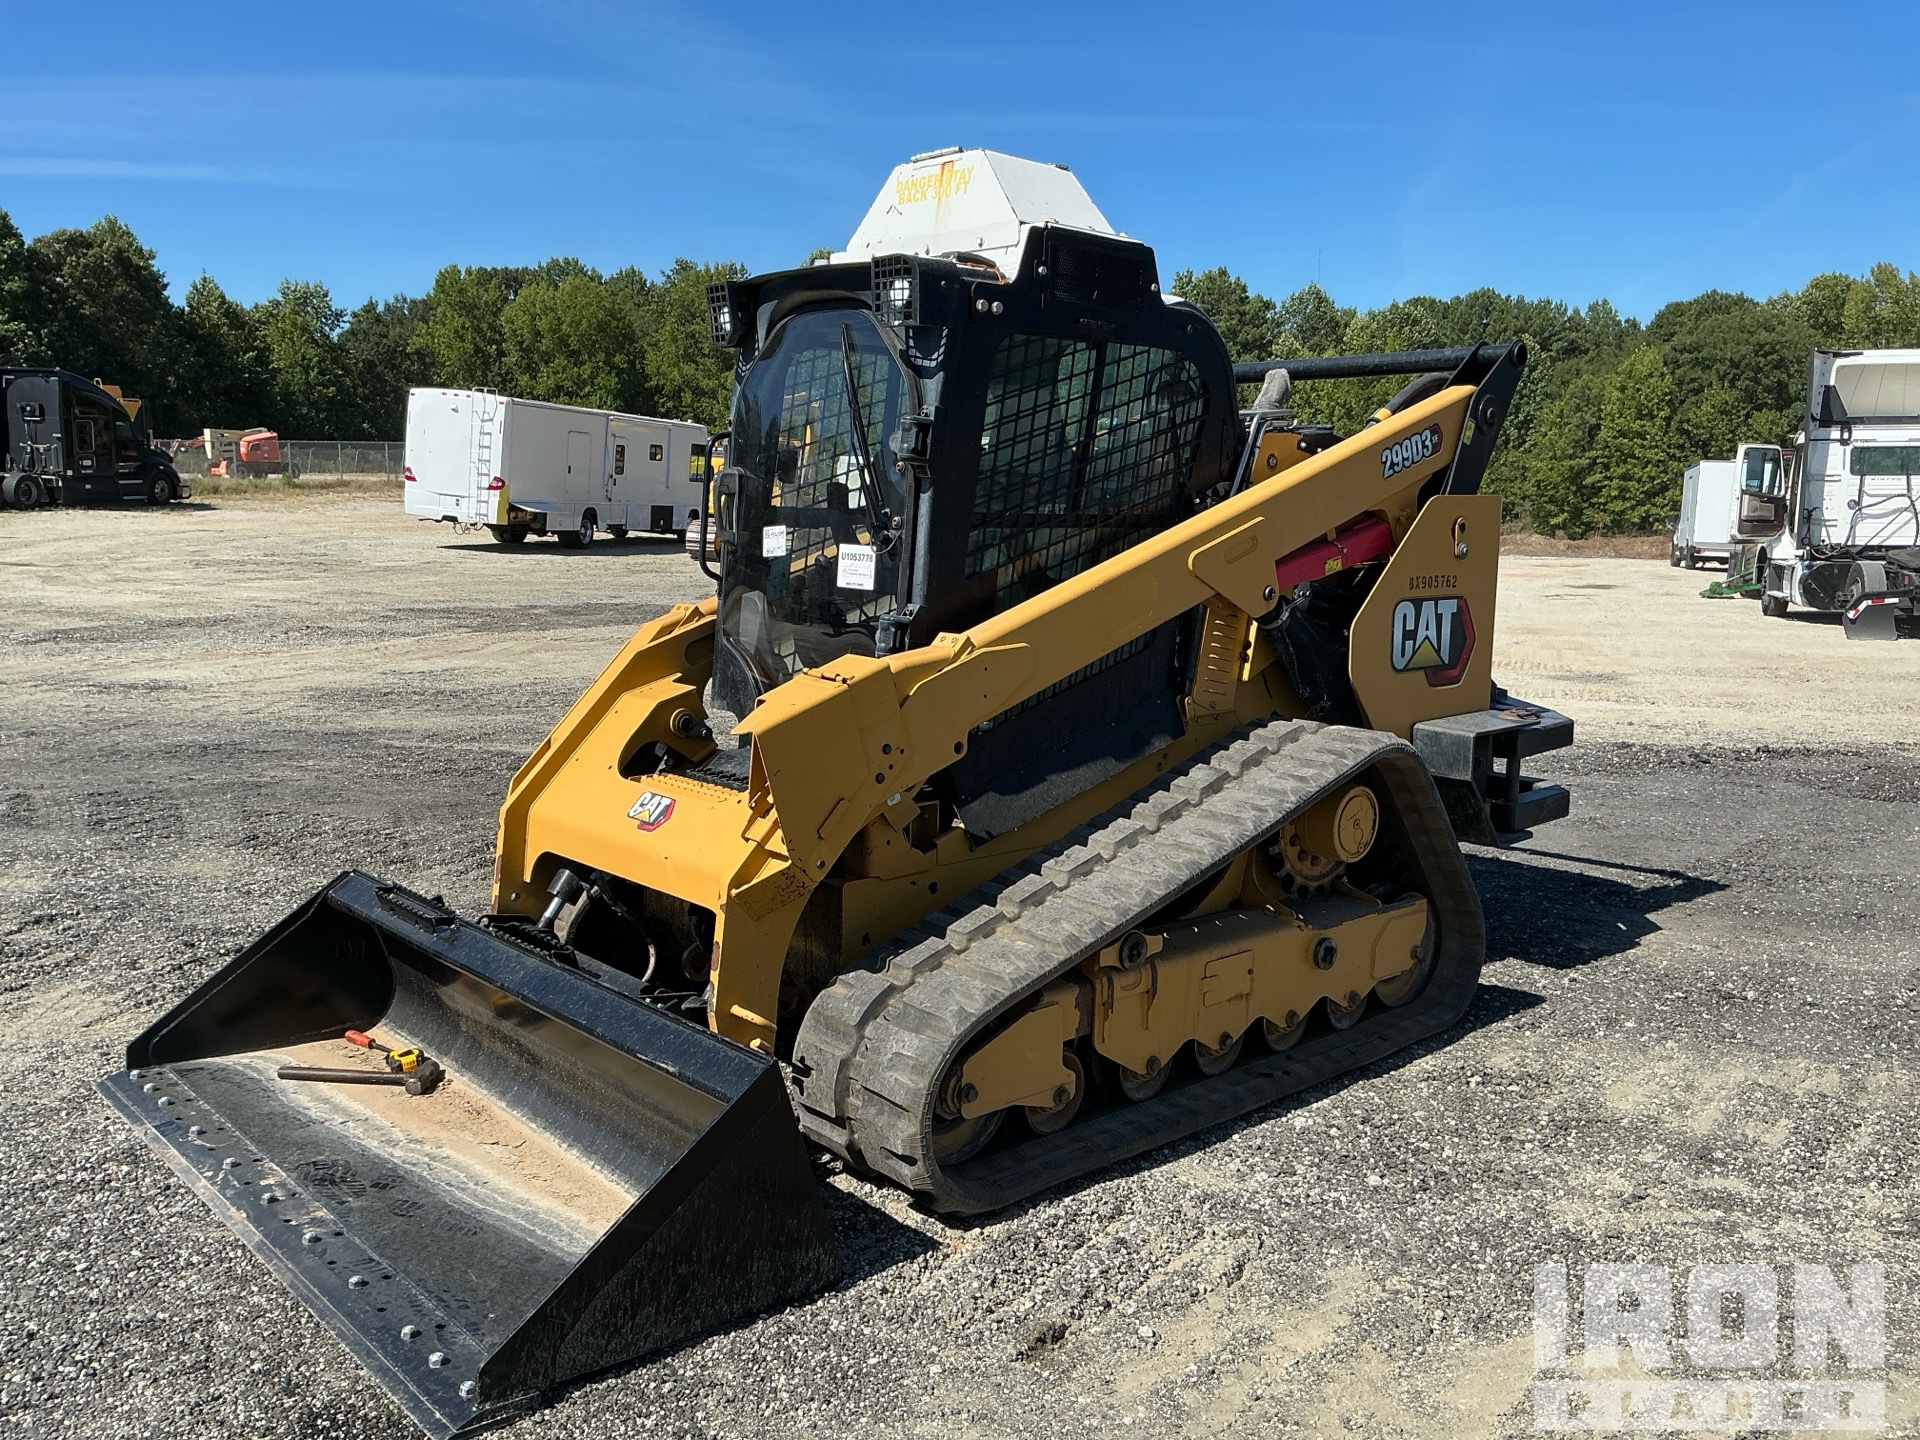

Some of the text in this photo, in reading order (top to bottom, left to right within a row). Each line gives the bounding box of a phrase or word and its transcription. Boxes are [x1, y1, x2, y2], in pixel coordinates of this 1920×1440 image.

[896, 166, 974, 193] DANGER STAY
[897, 189, 928, 206] BACK
[955, 180, 970, 195] FT
[1382, 429, 1433, 478] 299D3
[841, 551, 874, 563] U1053778
[1409, 575, 1458, 590] BX905762
[1392, 599, 1458, 670] CAT
[628, 791, 673, 824] CAT
